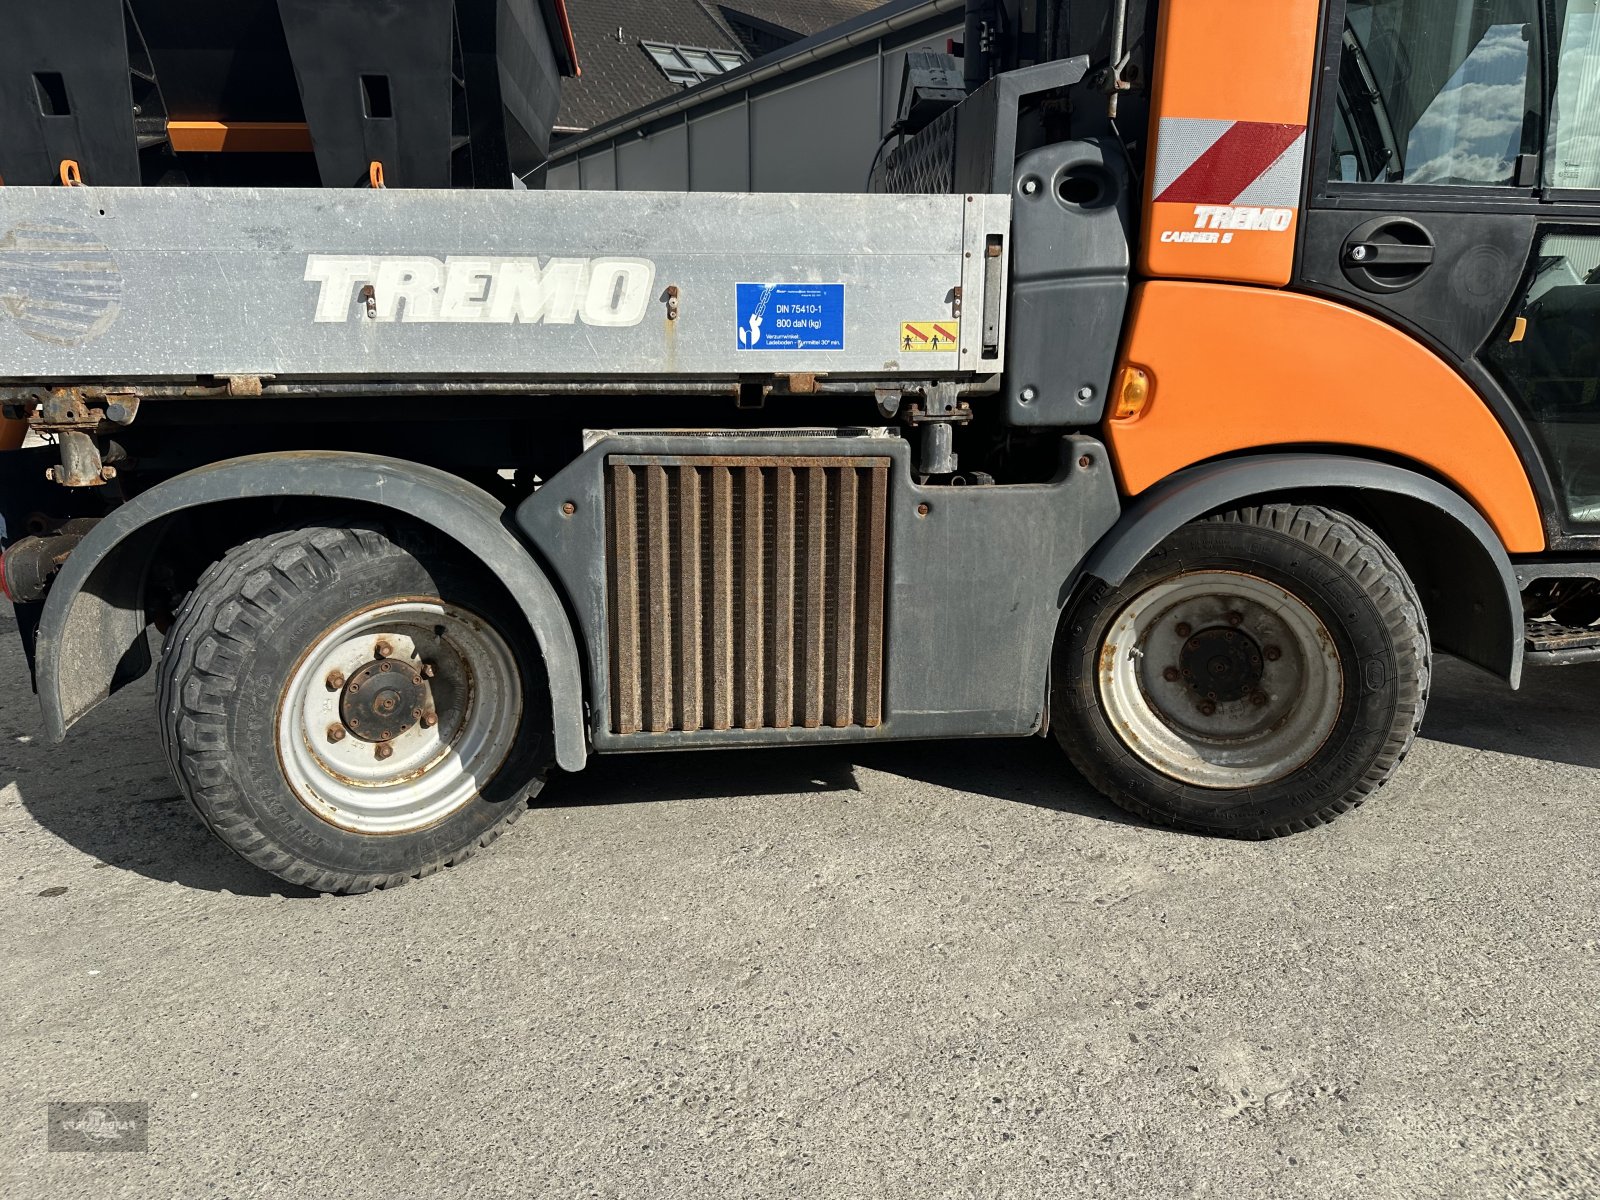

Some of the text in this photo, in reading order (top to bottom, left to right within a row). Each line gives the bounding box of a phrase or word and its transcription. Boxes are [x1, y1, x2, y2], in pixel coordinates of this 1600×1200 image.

[1193, 205, 1293, 231] TREMO
[304, 254, 656, 327] TREMO
[776, 304, 822, 314] DIN 75410-1
[776, 319, 822, 330] 800 daN (kg)
